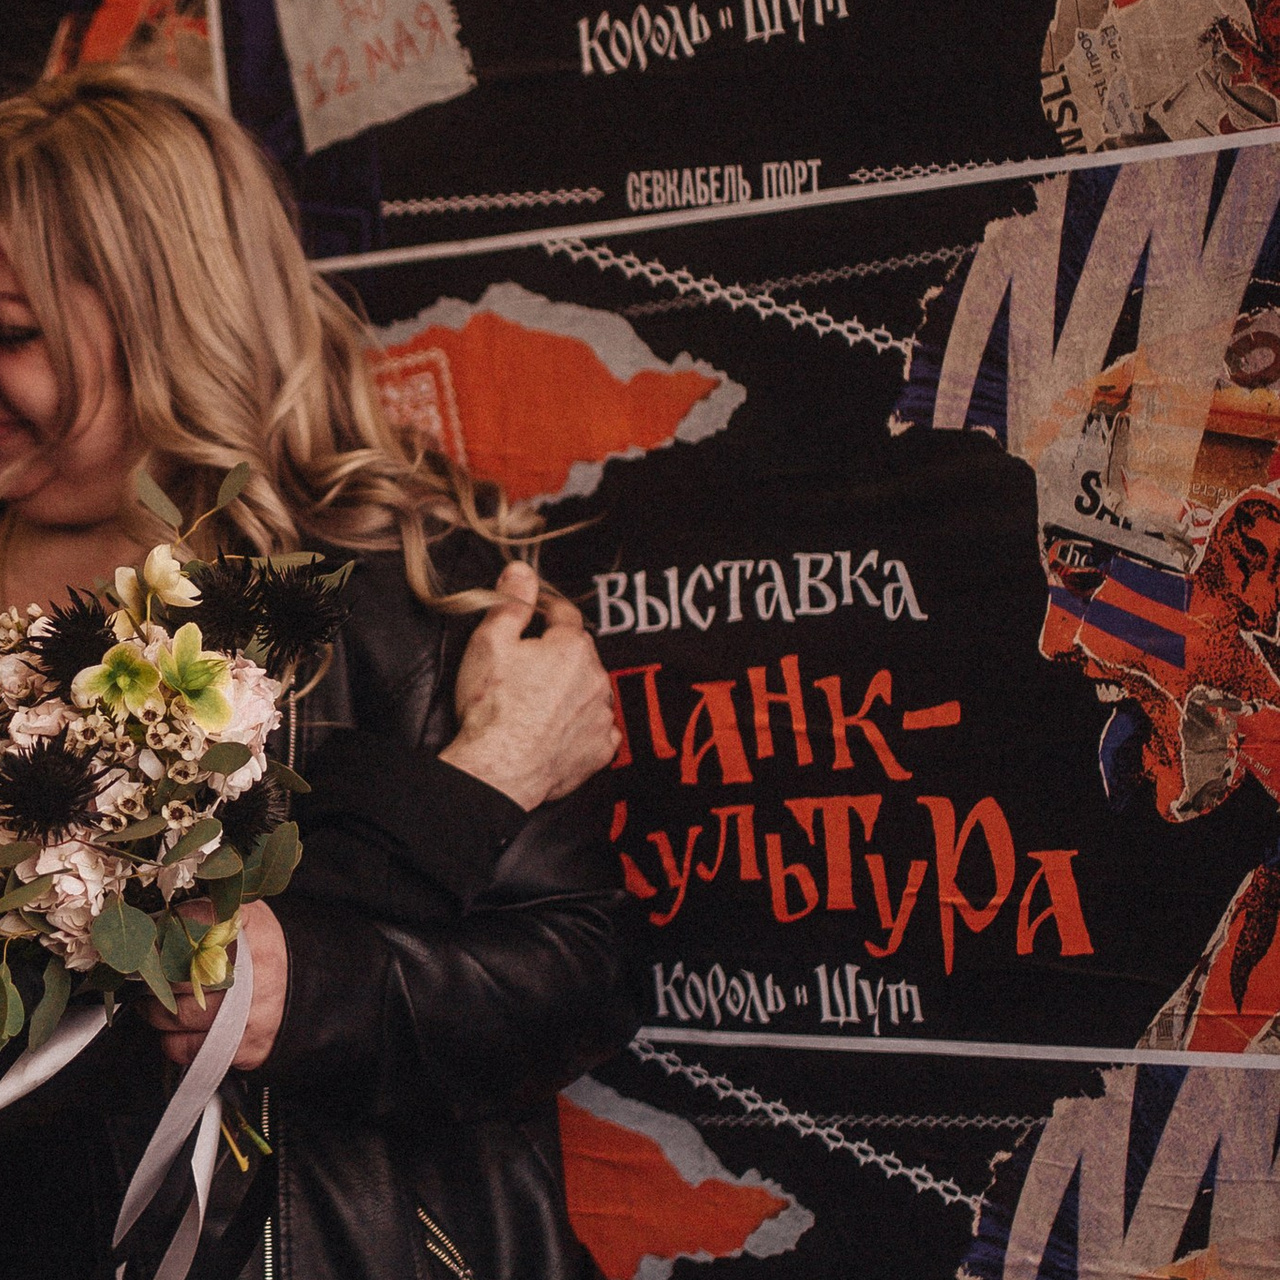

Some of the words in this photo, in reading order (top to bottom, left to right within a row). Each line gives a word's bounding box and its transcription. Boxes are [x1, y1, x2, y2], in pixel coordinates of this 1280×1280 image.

[365, 1, 448, 77] МАЯ
[626, 163, 753, 211] СЕВКАБЕЛЬ
[761, 158, 822, 201] ПОРТ
[592, 549, 929, 638] ВЫСТАВКА
[609, 653, 962, 786] ПАНК-
